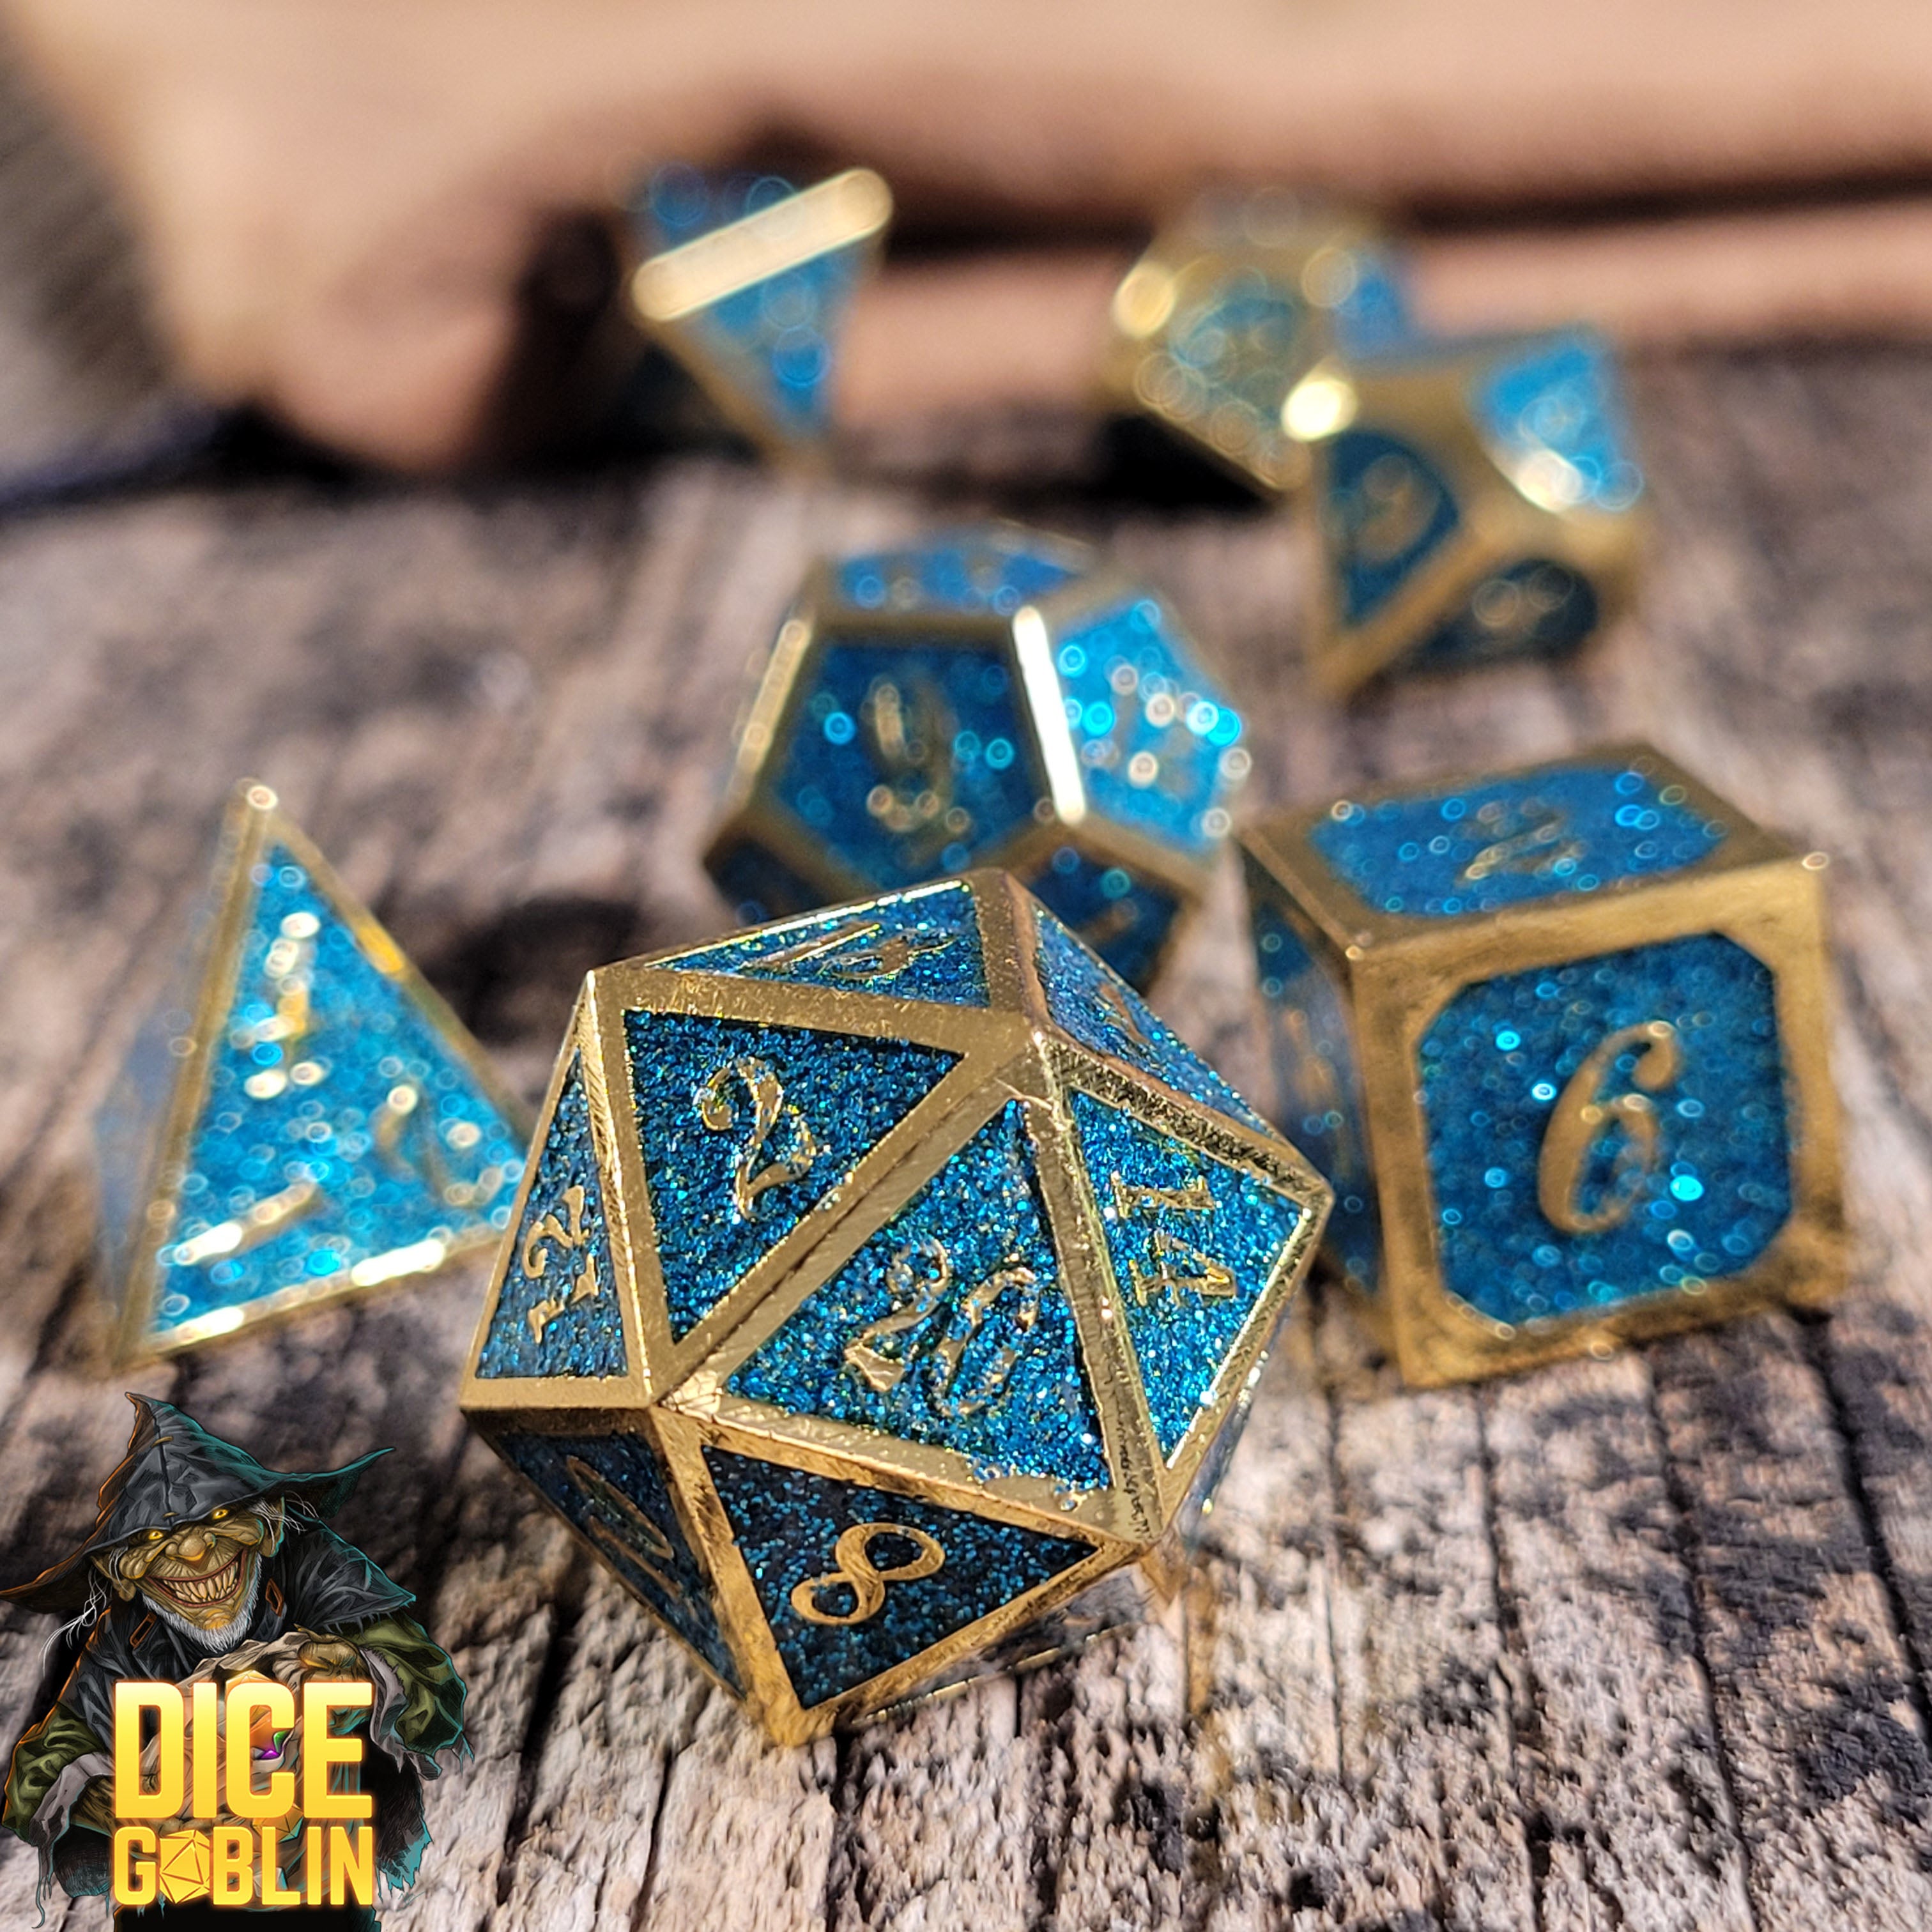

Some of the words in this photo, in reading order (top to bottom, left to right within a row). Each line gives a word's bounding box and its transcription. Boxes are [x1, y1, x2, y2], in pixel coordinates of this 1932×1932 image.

[693, 1056, 815, 1219] 2
[1538, 1021, 1680, 1236] 6
[521, 1184, 601, 1344] 12
[1112, 1172, 1236, 1308] 14
[845, 1238, 1036, 1415] 20
[791, 1522, 946, 1626] 8
